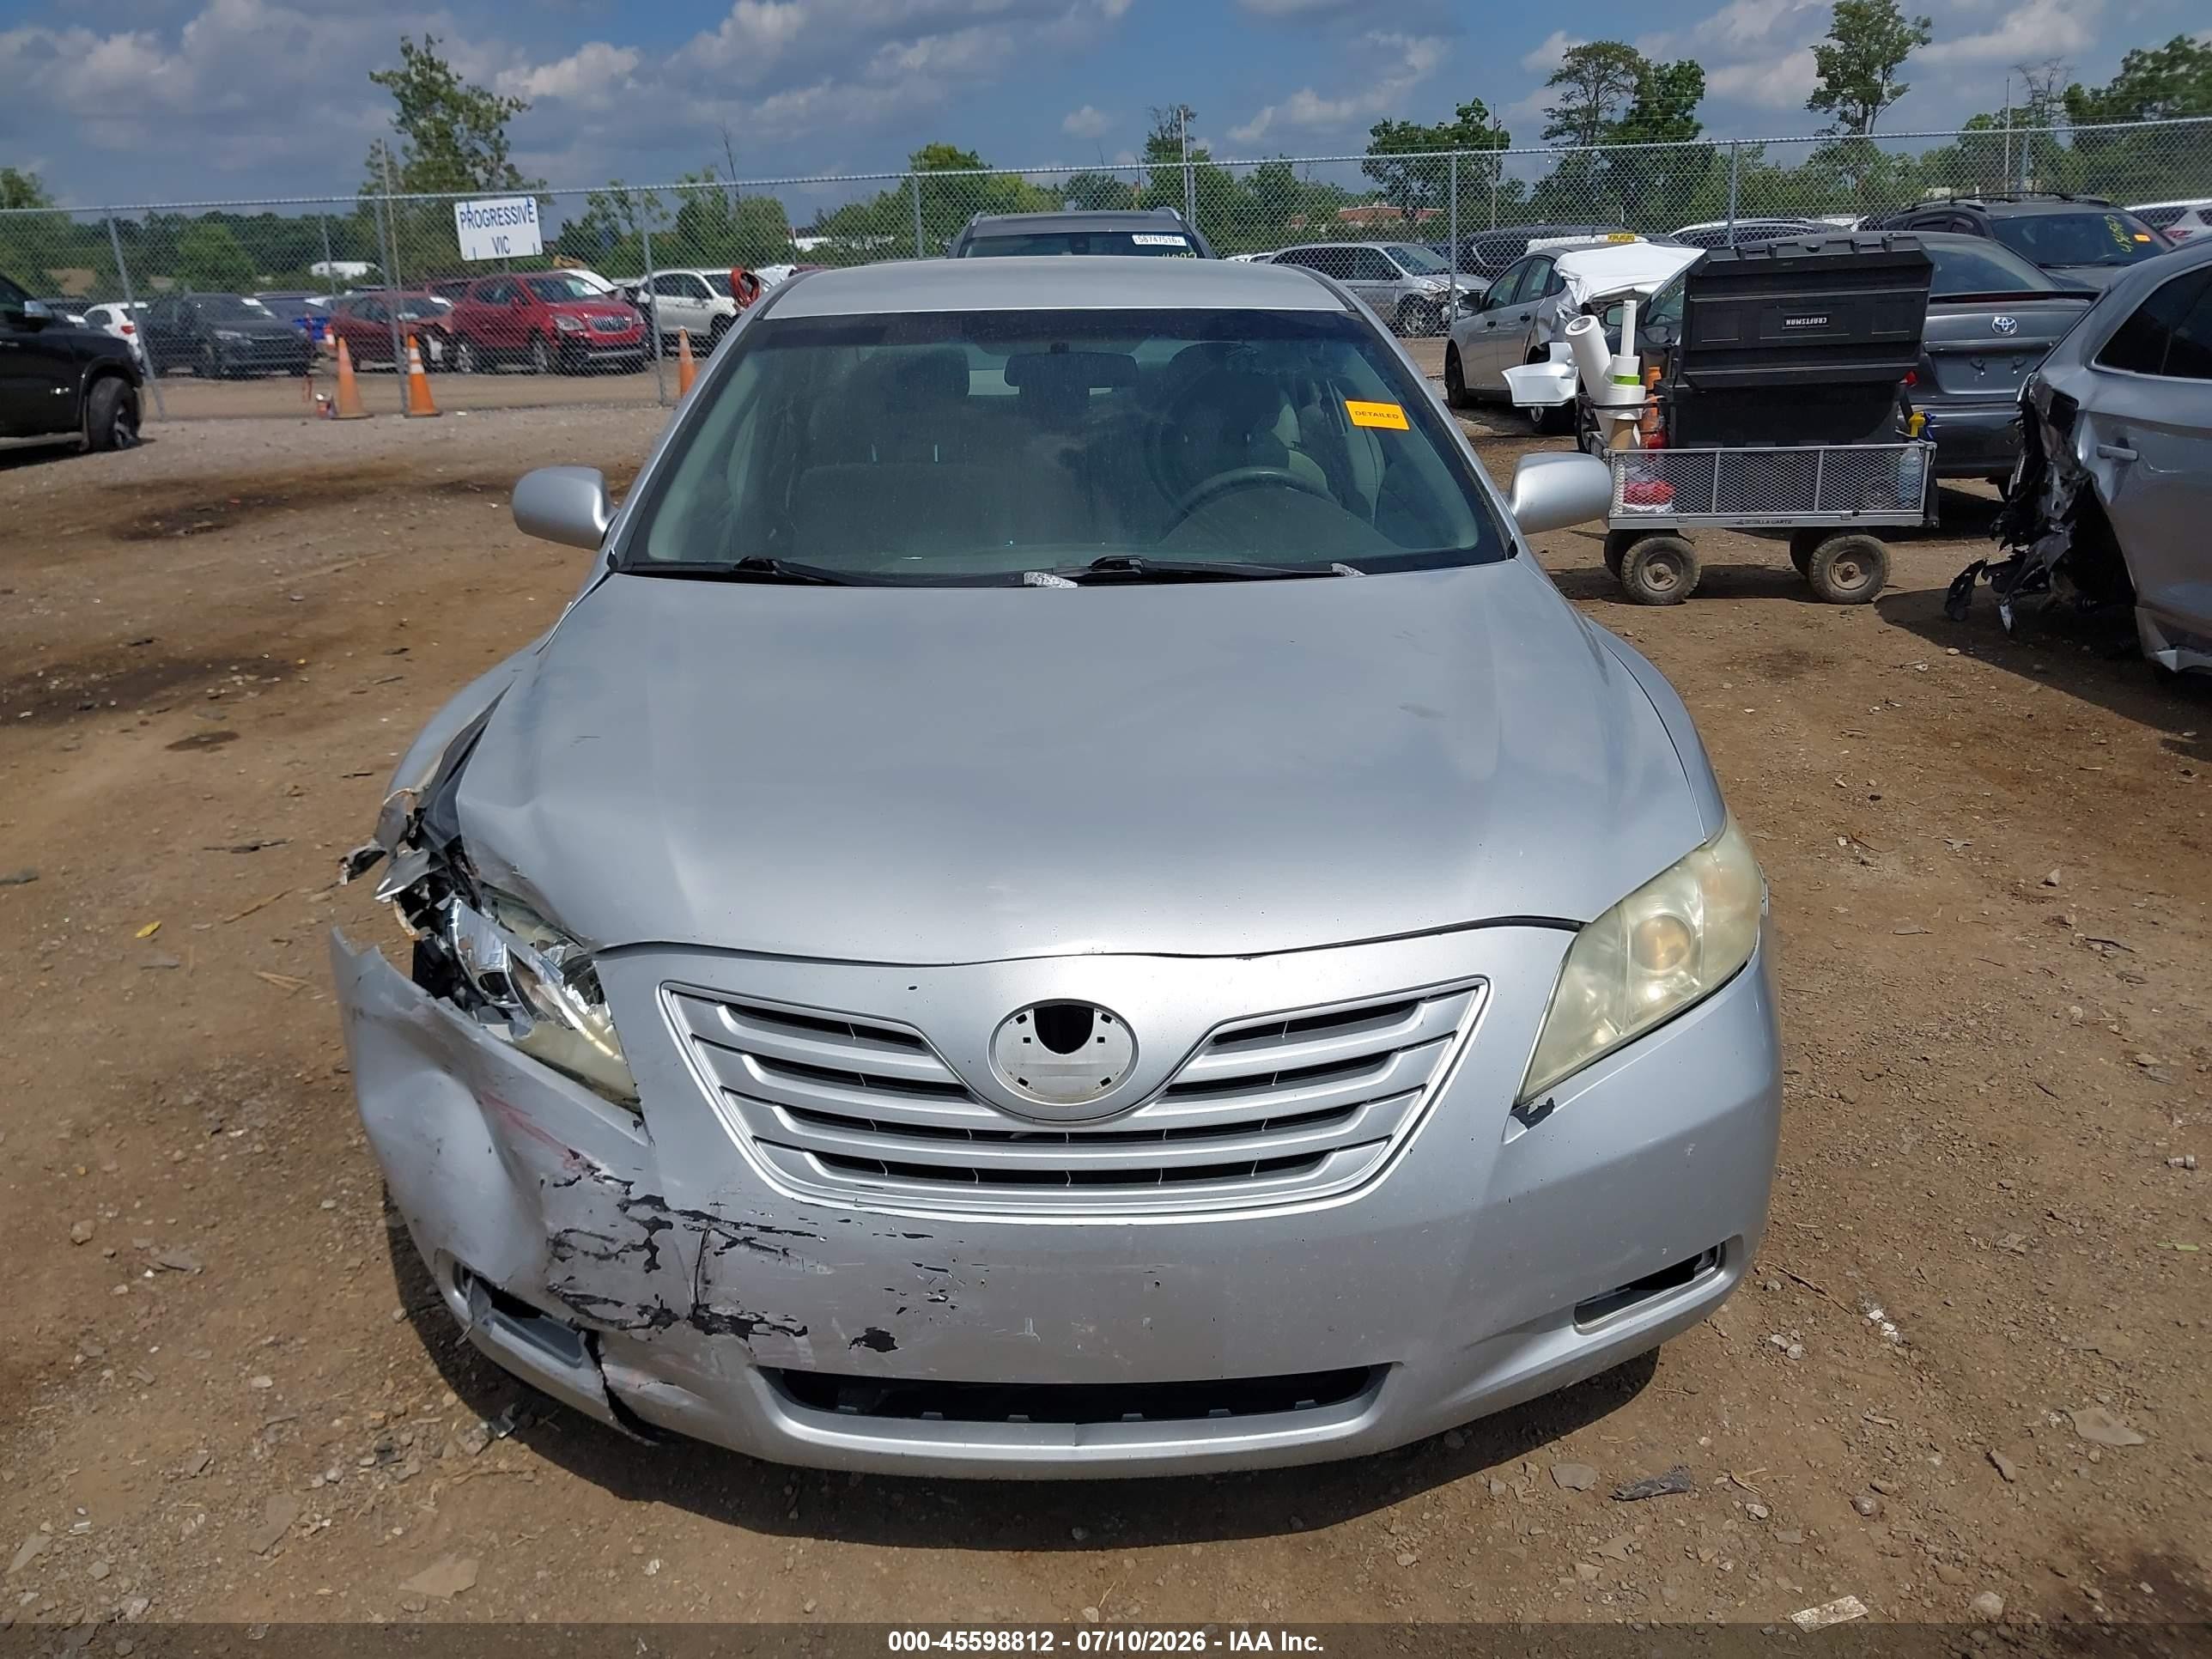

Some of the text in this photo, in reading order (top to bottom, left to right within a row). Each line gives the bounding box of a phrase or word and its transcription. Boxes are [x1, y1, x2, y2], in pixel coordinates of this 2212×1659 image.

[459, 204, 535, 230] PROGRESSIVE
[491, 235, 511, 255] VIC
[1785, 317, 1827, 325] CRAFTSMAN
[1354, 410, 1400, 419] DETAILED
